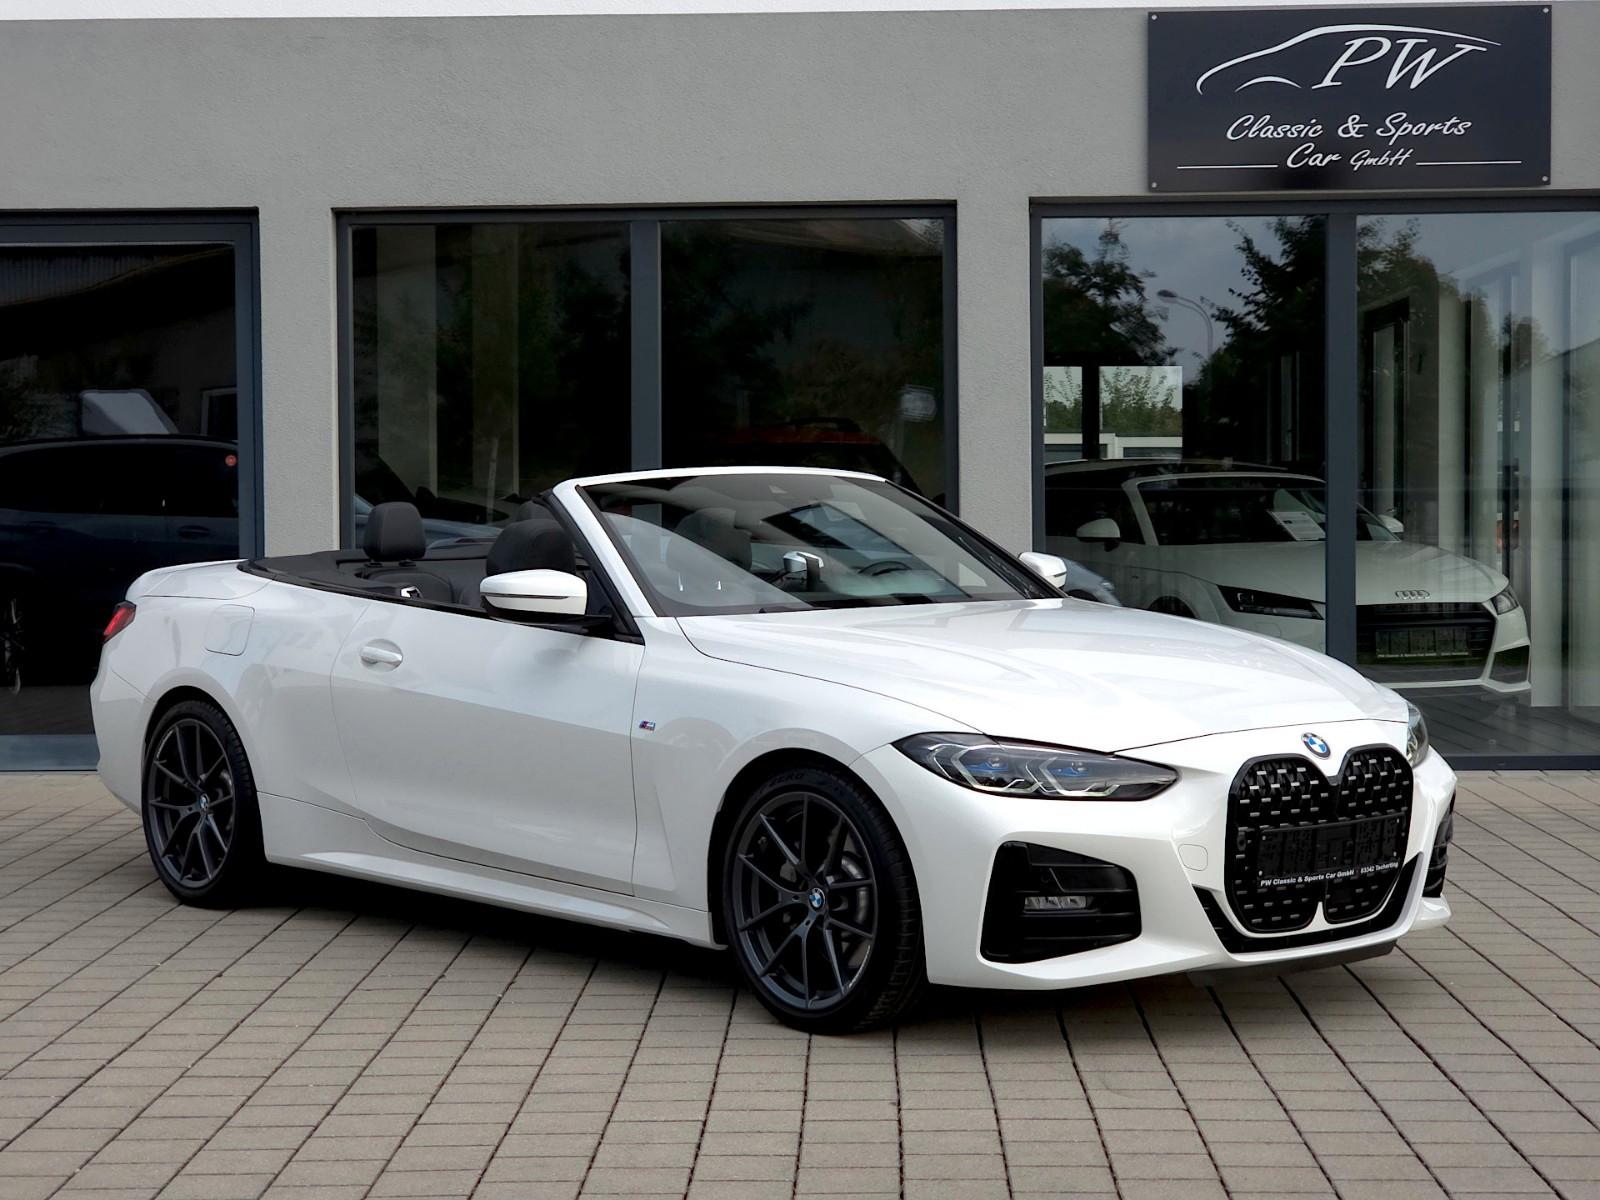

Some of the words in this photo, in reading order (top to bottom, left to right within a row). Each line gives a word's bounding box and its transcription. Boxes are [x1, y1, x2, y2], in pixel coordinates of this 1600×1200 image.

[1311, 36, 1488, 90] PW
[1225, 114, 1323, 141] Classic
[1337, 114, 1368, 138] &
[1376, 112, 1473, 146] Sports
[1286, 143, 1341, 169] Car
[1350, 148, 1414, 171] GmbH
[1260, 879, 1272, 887] PW
[1273, 877, 1296, 885] Classic
[1304, 874, 1325, 883] Sports
[1337, 869, 1355, 878] GmbH
